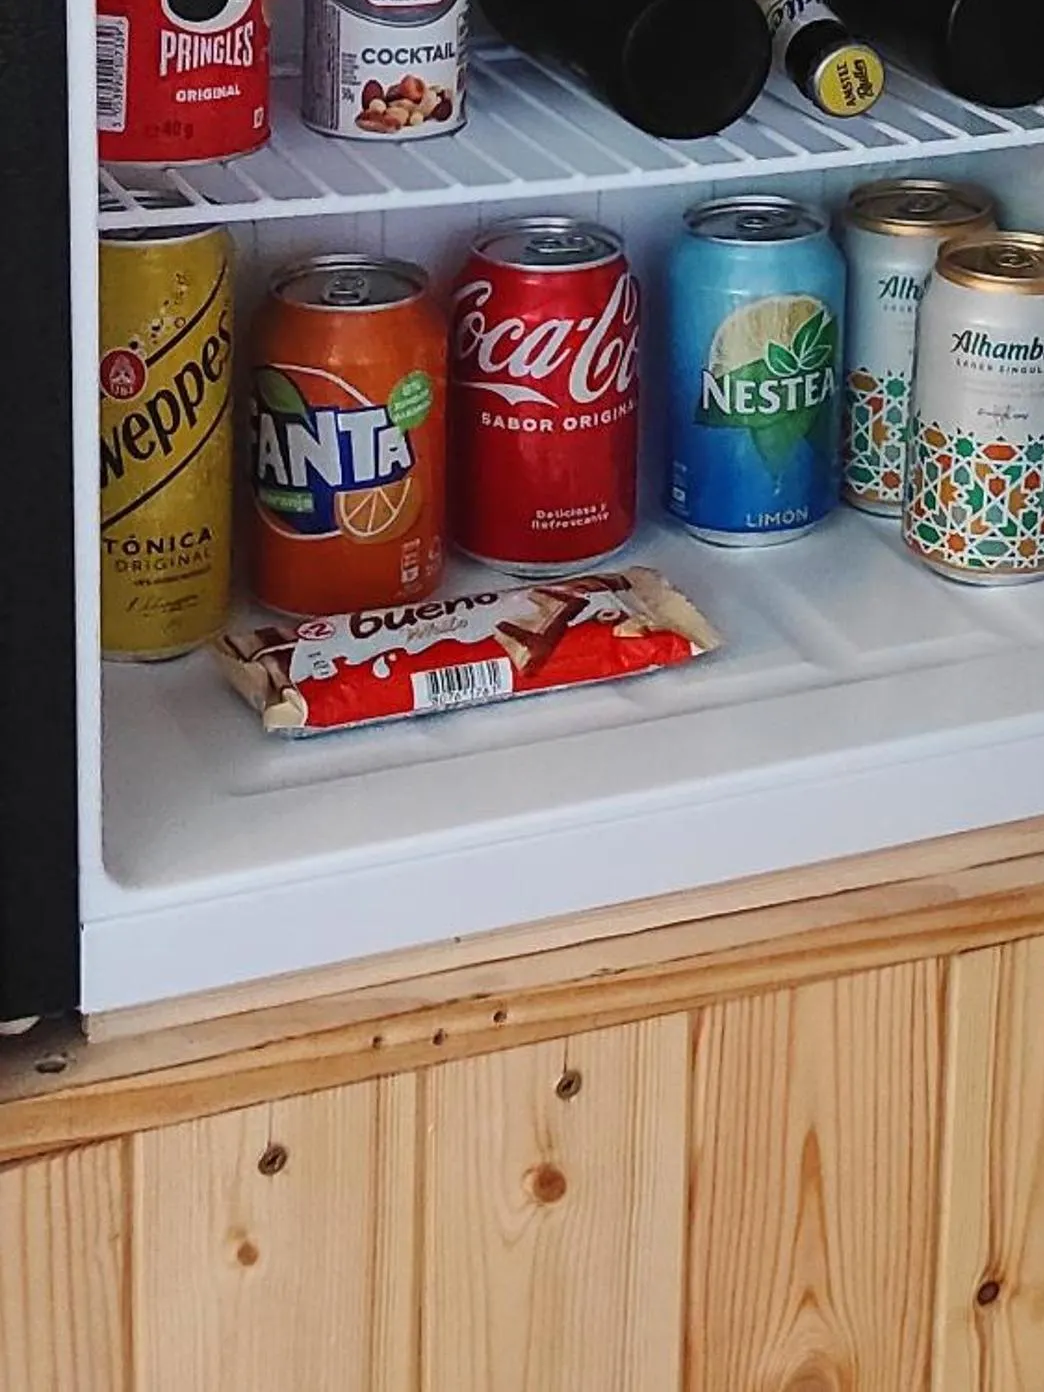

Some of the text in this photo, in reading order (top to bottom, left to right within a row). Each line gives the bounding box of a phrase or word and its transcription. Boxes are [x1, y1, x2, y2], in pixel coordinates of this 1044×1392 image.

[159, 20, 254, 77] PRINGLES
[361, 42, 455, 65] COCKTAIL
[175, 83, 241, 102] ORIGINAL
[702, 367, 837, 416] NESTEA
[481, 411, 554, 434] SABOR
[103, 527, 212, 556] TÓNICA
[115, 548, 211, 573] ORIGINAL
[349, 592, 499, 640] bueno
